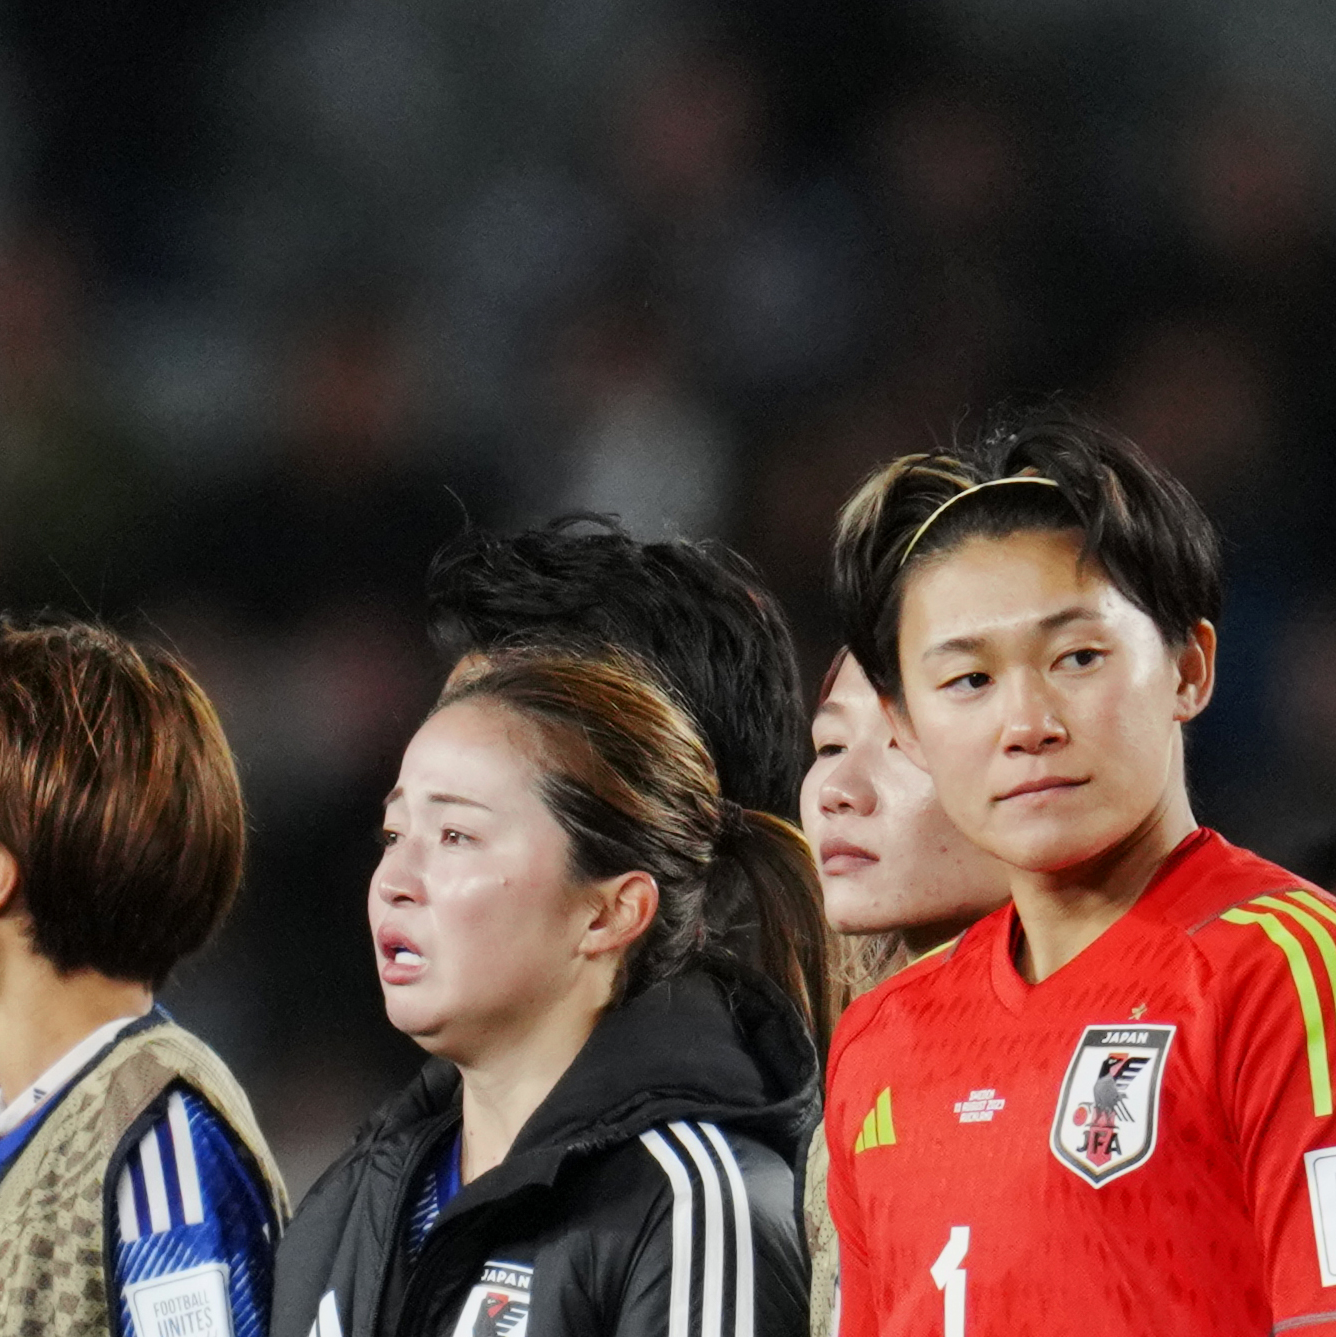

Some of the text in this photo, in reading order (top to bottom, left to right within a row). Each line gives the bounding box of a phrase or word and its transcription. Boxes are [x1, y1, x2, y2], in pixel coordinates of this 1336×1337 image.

[1101, 1031, 1149, 1044] JAPAN
[1076, 1130, 1122, 1156] JFA
[481, 1268, 531, 1289] JAPAN
[153, 1289, 210, 1318] FOOTBALL
